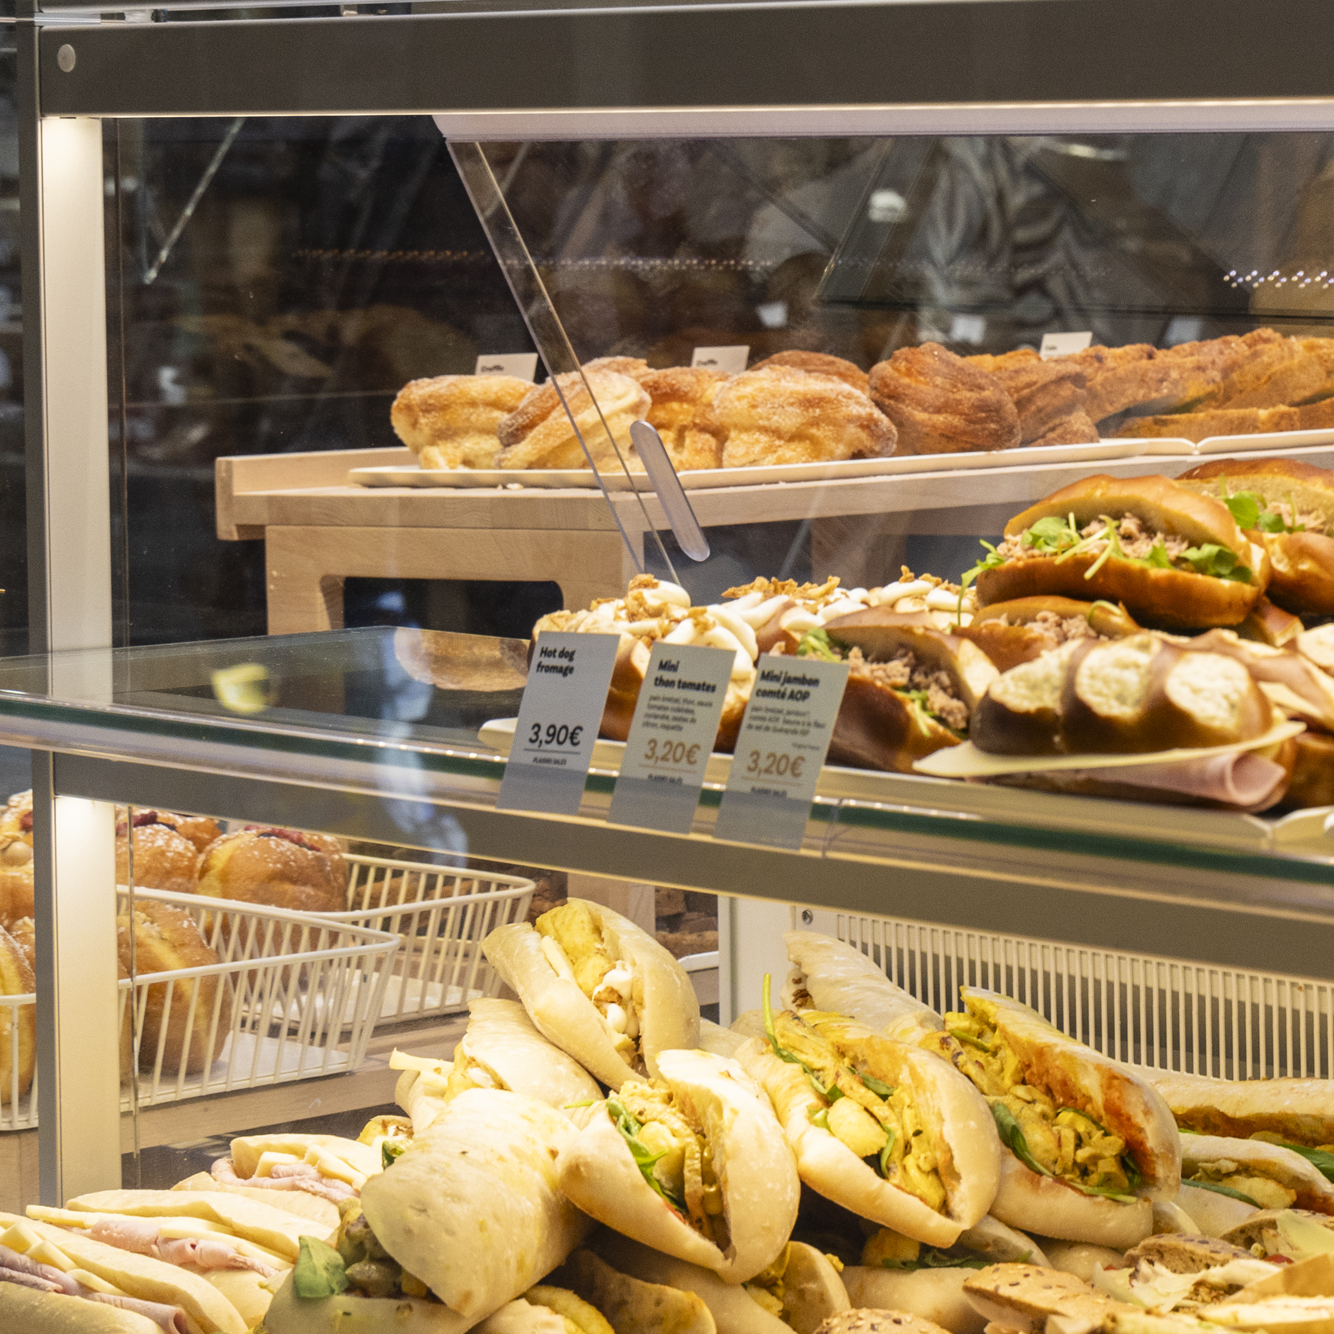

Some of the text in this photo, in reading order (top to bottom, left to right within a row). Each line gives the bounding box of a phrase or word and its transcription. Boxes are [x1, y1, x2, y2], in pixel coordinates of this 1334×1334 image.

[539, 646, 576, 661] Hot dog
[535, 661, 575, 677] fromage
[657, 659, 680, 672] Mini
[653, 675, 717, 693] thon tomates
[759, 669, 820, 687] Mini jambon
[755, 687, 810, 702] comté AOP
[528, 722, 583, 747] 3,90€
[643, 737, 701, 765] 3,20€
[746, 749, 805, 778] 3,20€
